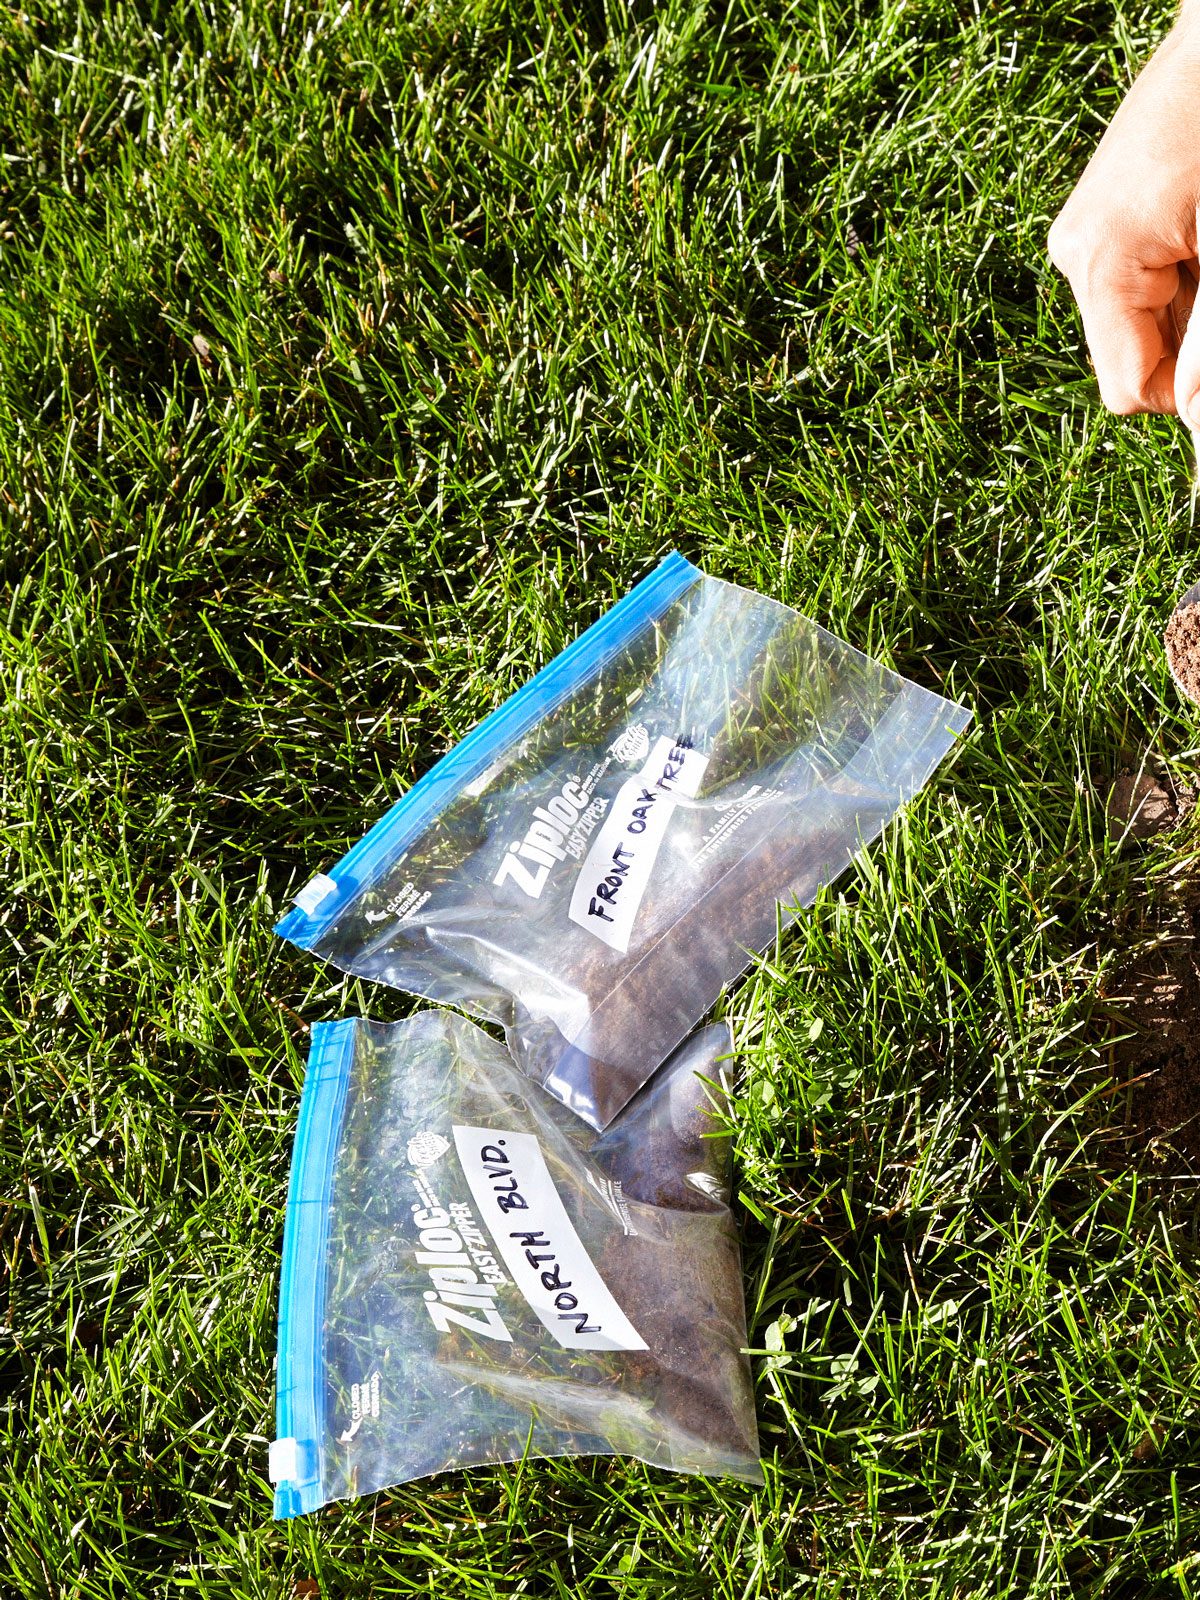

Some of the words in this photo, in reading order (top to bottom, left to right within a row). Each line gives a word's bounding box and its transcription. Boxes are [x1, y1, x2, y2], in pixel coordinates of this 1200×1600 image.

[564, 827, 588, 860] EASY
[576, 796, 610, 836] ZIPPER
[587, 841, 636, 923] FRONT
[626, 788, 658, 835] OAK
[655, 732, 695, 792] TREE
[708, 807, 738, 834] FAMILY
[386, 882, 415, 912] CLOSED
[480, 1139, 530, 1214] BLVD.
[448, 1201, 488, 1248] ZIPPER
[468, 1246, 509, 1284] EASY
[509, 1231, 602, 1334] NORTH
[351, 1382, 362, 1420] CLOSED
